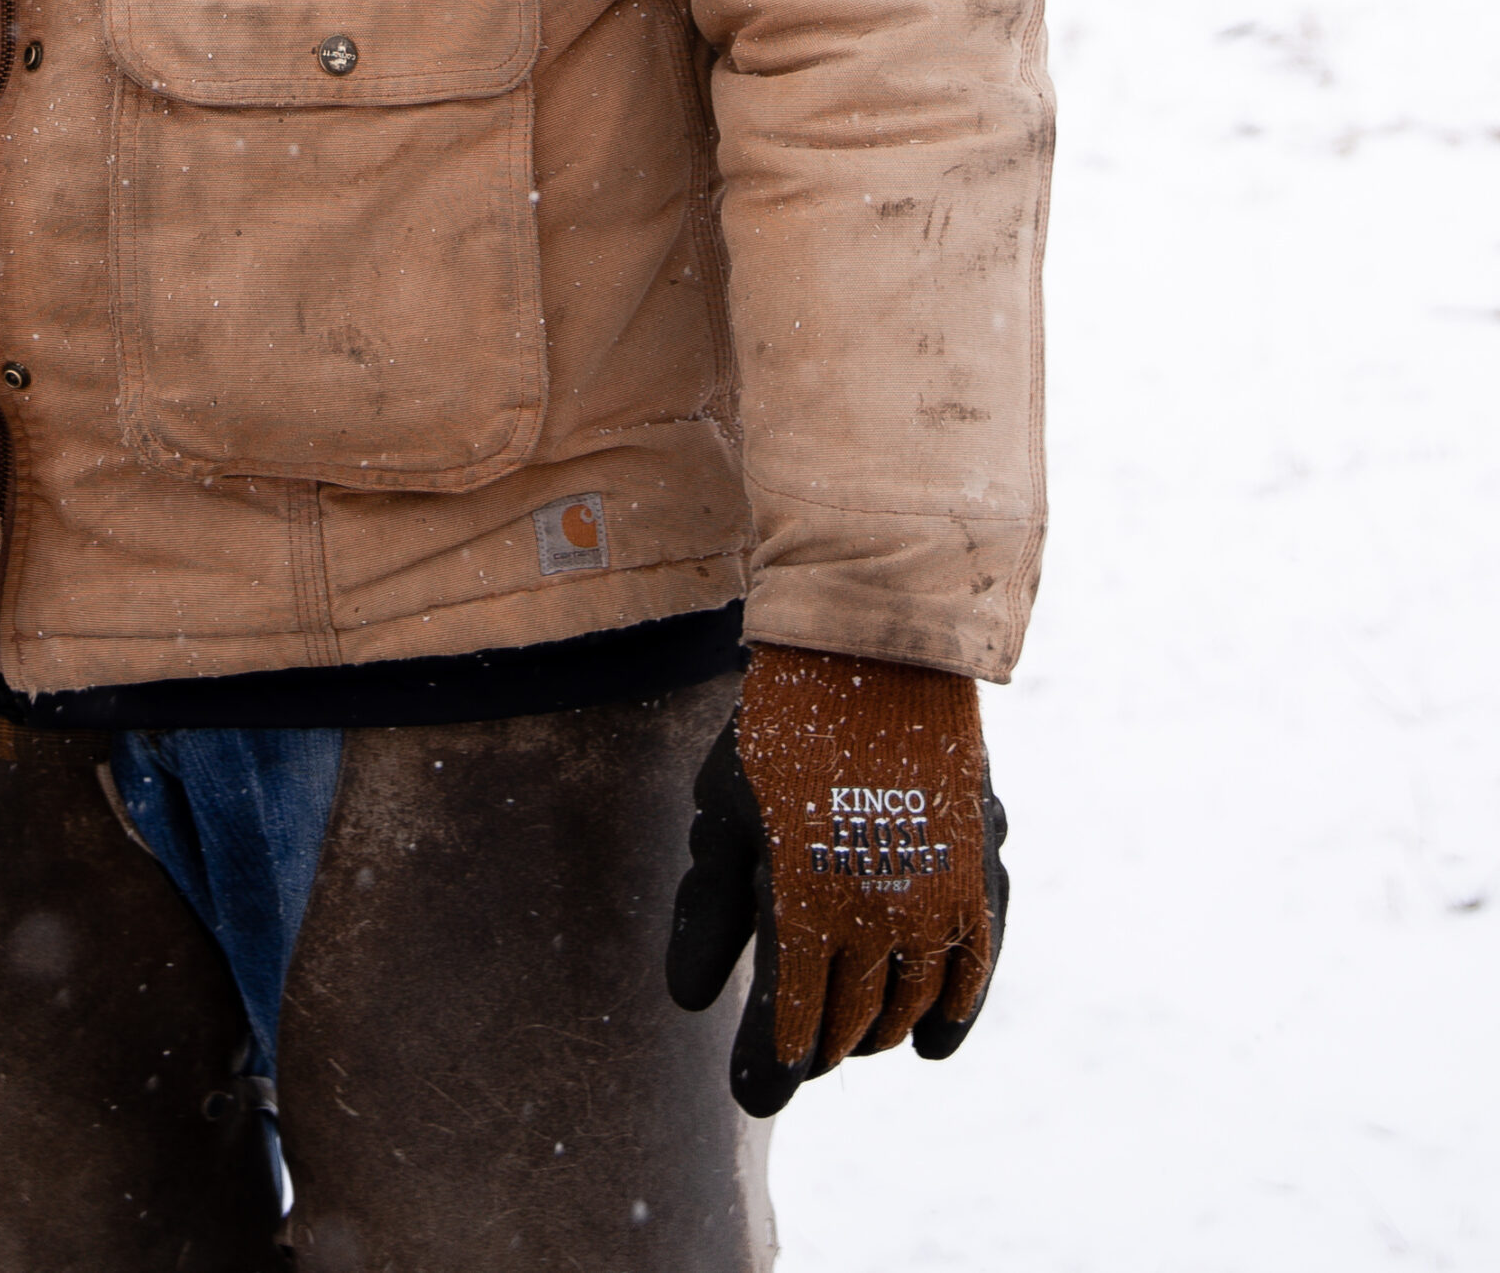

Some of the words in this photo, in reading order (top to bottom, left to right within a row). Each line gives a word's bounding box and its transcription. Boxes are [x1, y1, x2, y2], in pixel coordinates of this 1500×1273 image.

[830, 787, 925, 813] KINCO
[832, 815, 927, 848] FROST
[810, 842, 951, 876] BREAKER
